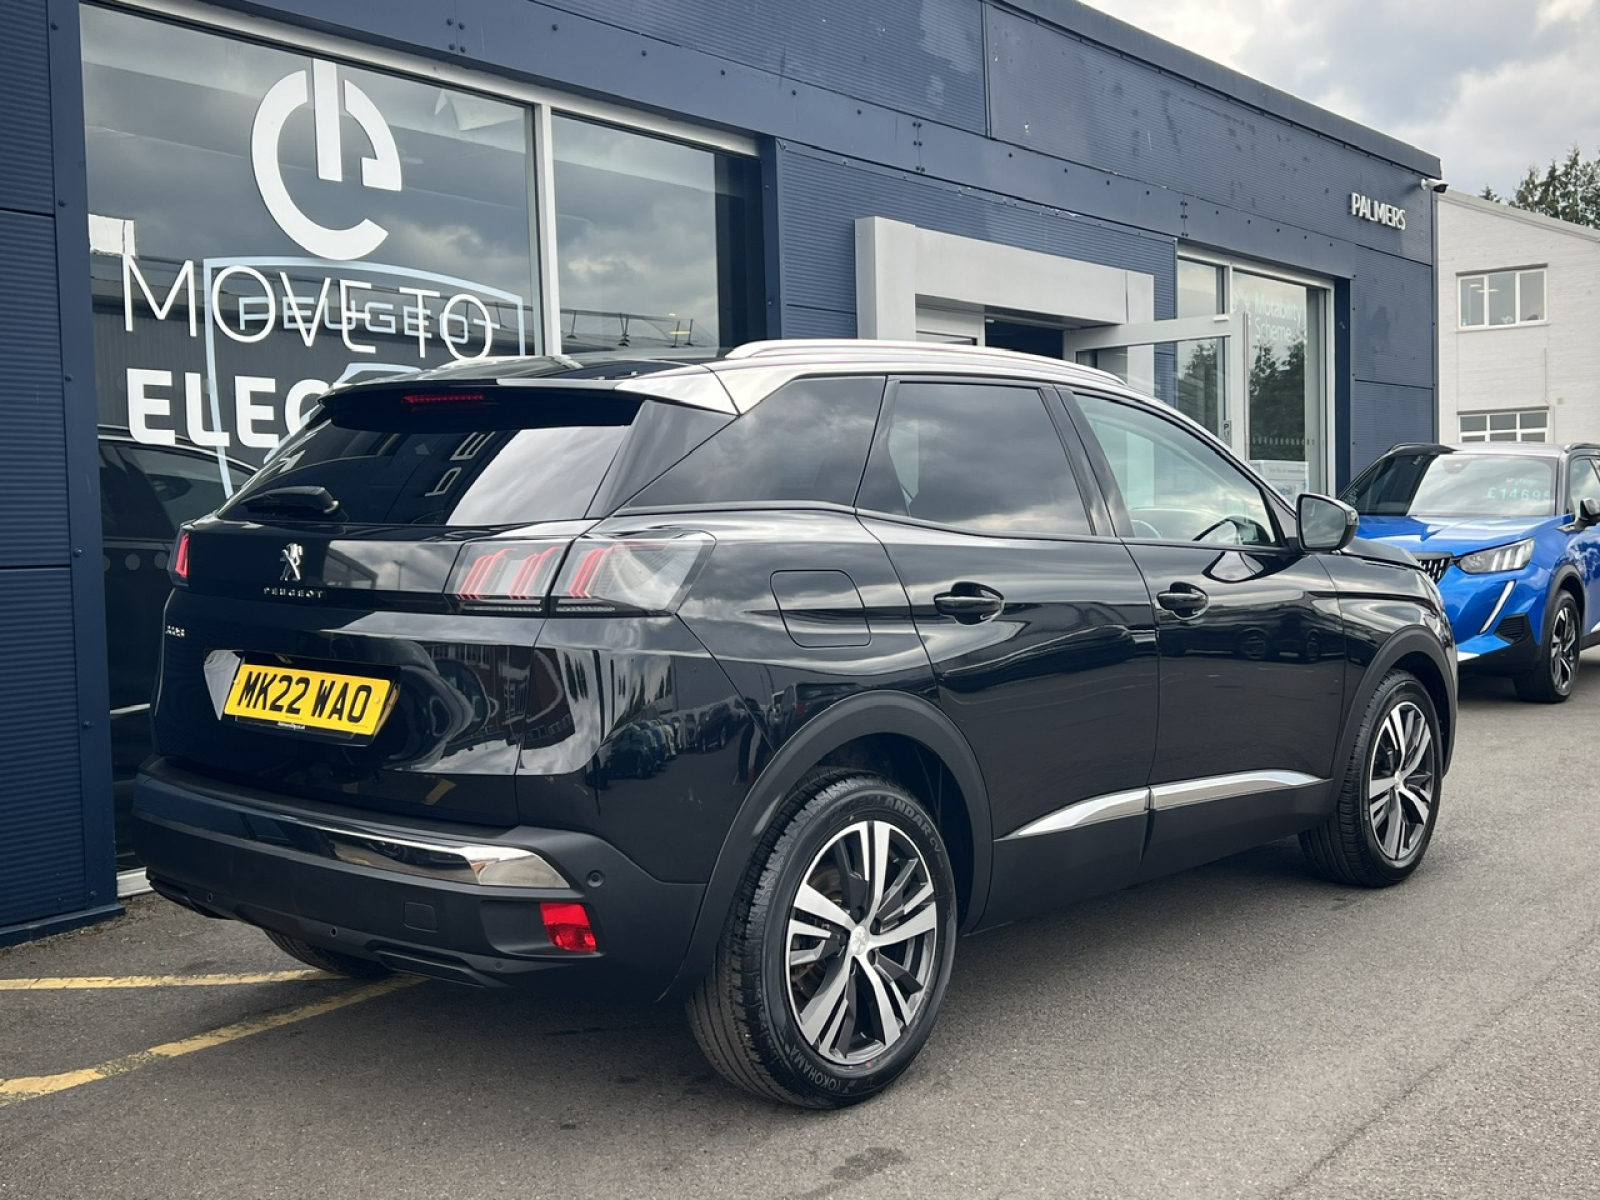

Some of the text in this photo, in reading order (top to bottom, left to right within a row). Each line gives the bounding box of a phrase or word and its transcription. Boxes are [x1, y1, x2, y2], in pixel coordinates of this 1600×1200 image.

[1351, 192, 1406, 231] PALMERS
[122, 253, 493, 361] MOVE TO
[238, 295, 500, 345] PEUGEOT
[1254, 292, 1302, 327] Motability
[1254, 317, 1293, 343] Scheme
[263, 586, 323, 599] PEUGEOT
[236, 670, 373, 724] MK22 WAO
[790, 1044, 844, 1092] YOKOHAMA
